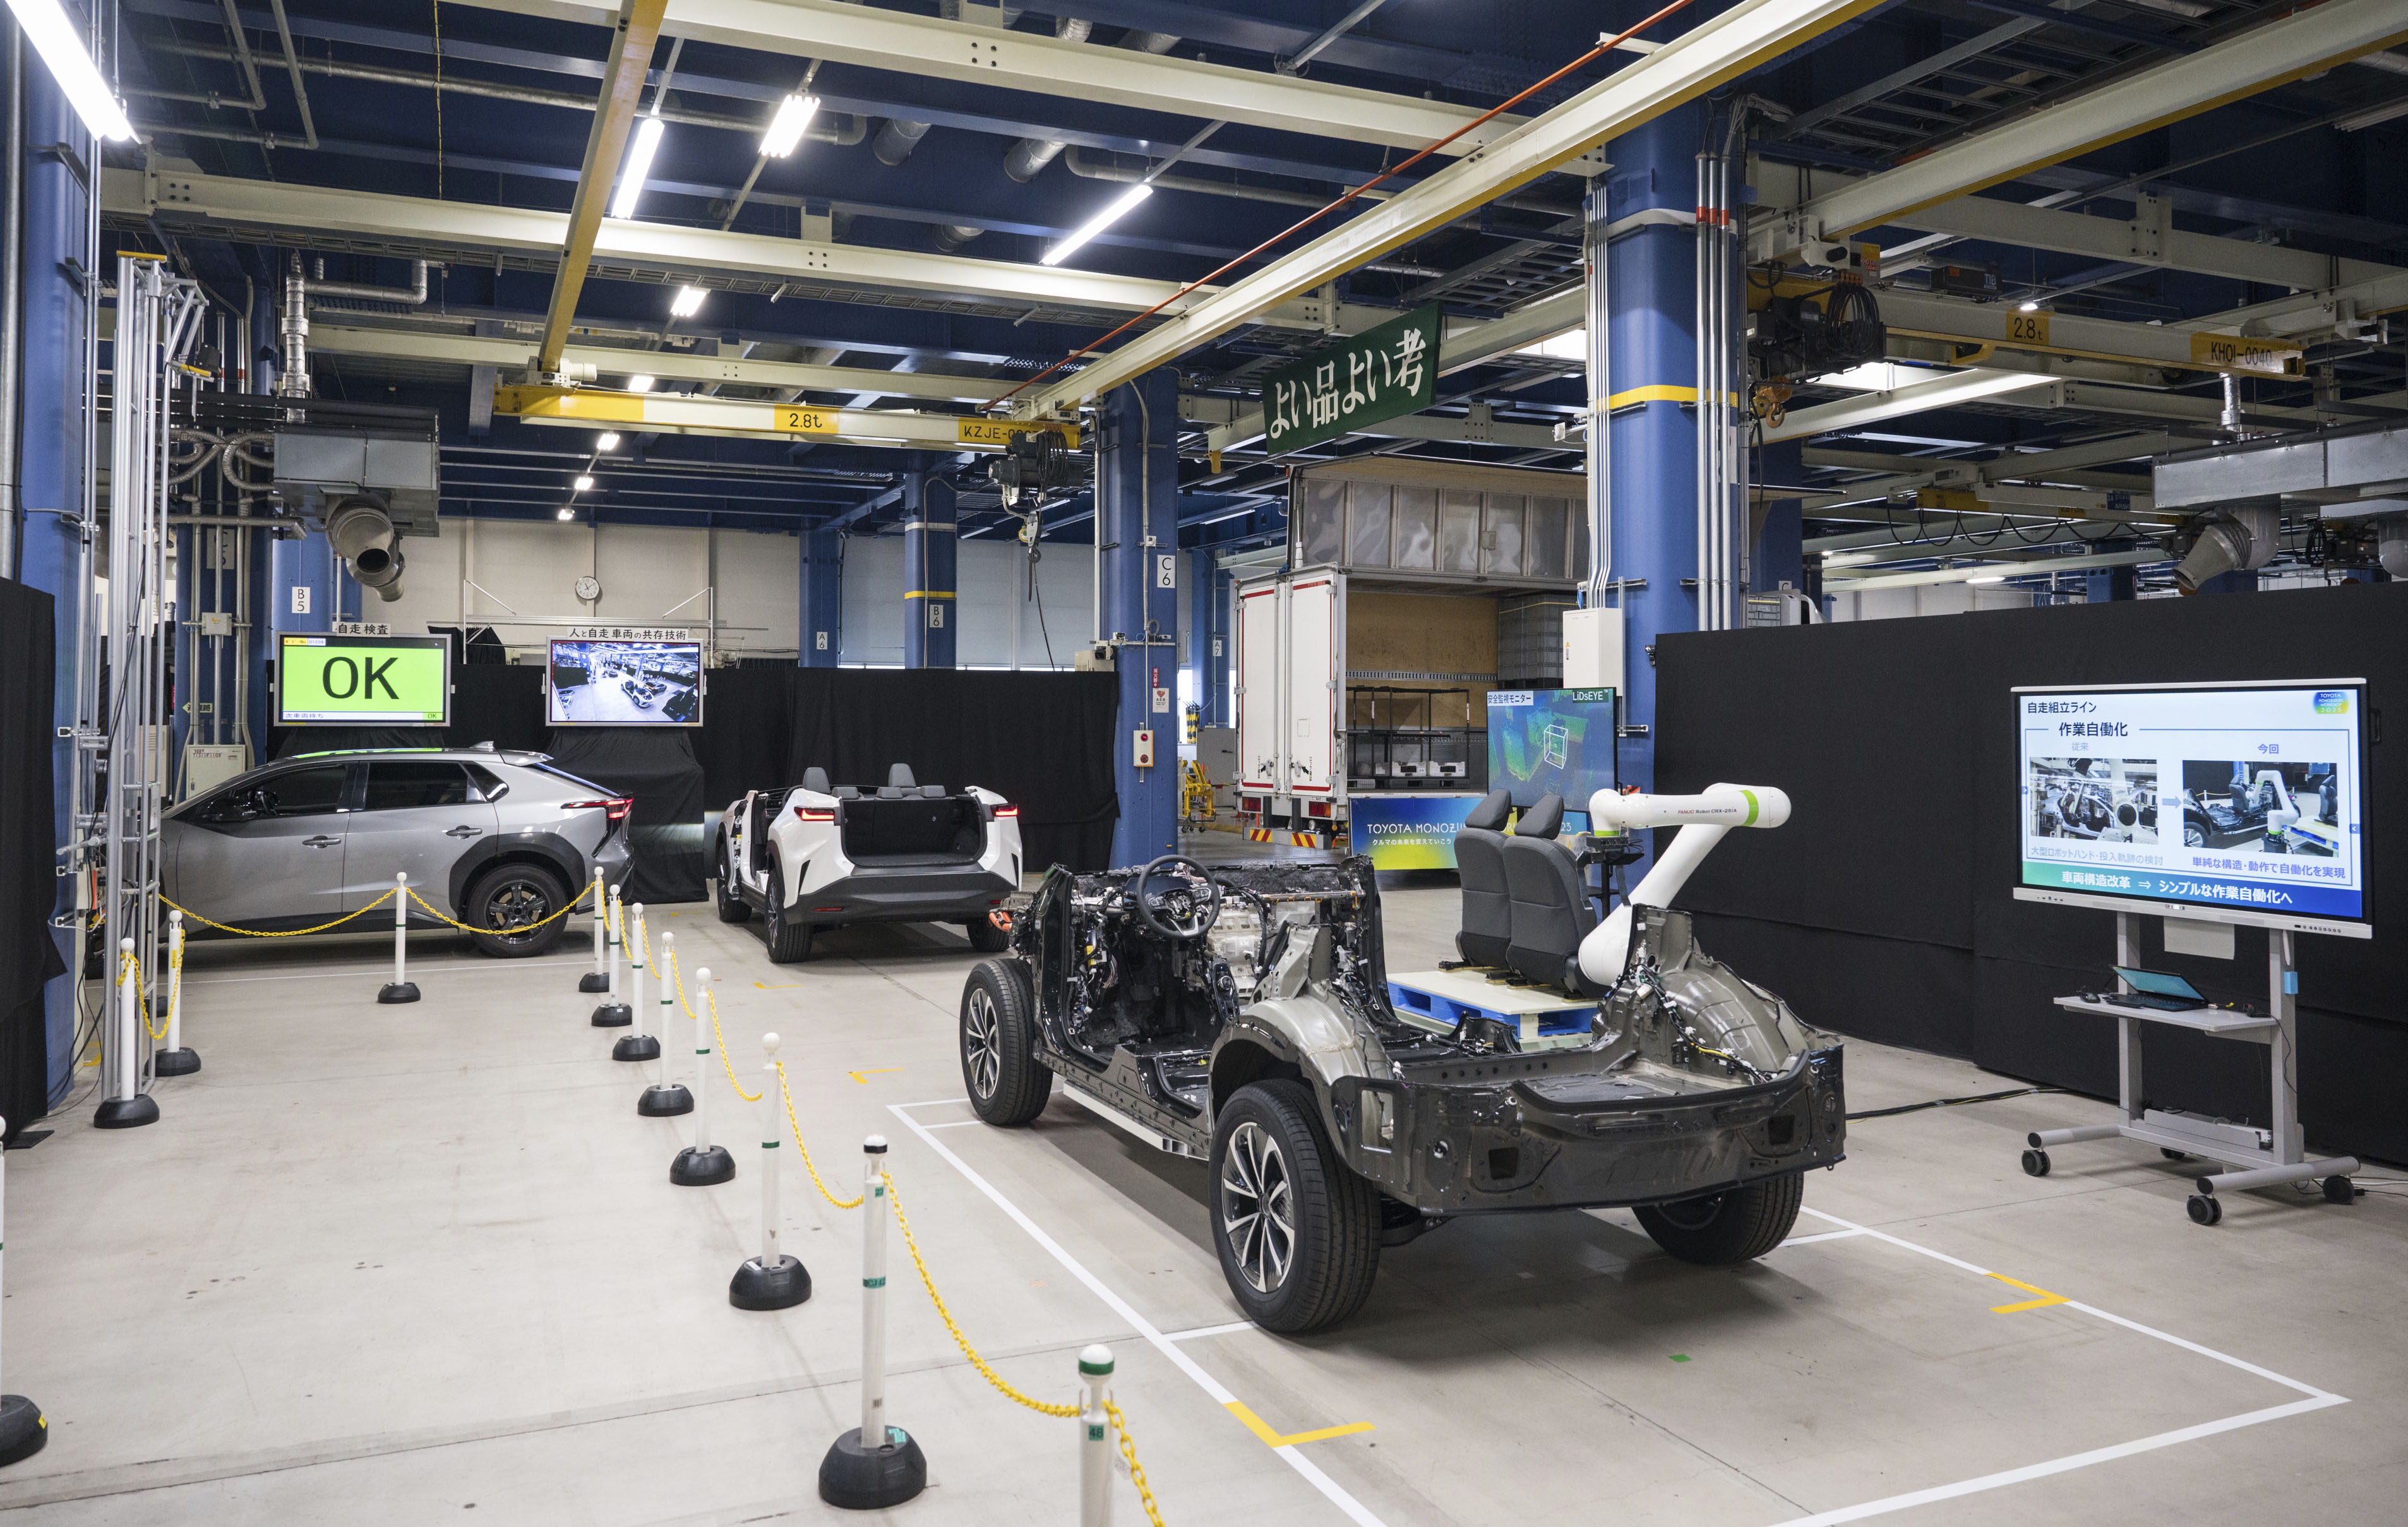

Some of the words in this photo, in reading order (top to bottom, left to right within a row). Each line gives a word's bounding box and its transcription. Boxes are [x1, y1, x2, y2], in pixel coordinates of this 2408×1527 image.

[1270, 328, 1427, 439] よい品よい考
[789, 413, 822, 428] 2.8t
[338, 623, 388, 635] 自走検査
[570, 628, 686, 640] 人と自走車両の共存技術
[323, 657, 399, 699] OK
[1487, 694, 1531, 704] 安全監視モニター
[1572, 690, 1603, 701] LiDsEYE
[2028, 701, 2097, 714] 自走組立ライン
[2059, 722, 2128, 737] 作業自働化
[2071, 742, 2089, 752] 従来
[2258, 744, 2279, 754] 今回
[1367, 823, 1412, 834] TOYOTA
[1416, 822, 1466, 833] MONOZU
[2193, 856, 2346, 879] 単純な構造・動作で自働化を実現
[2062, 871, 2131, 889] 車両構造改革
[2159, 880, 2293, 904] シンプルな作業自働化へ
[1089, 1427, 1104, 1438] 48
